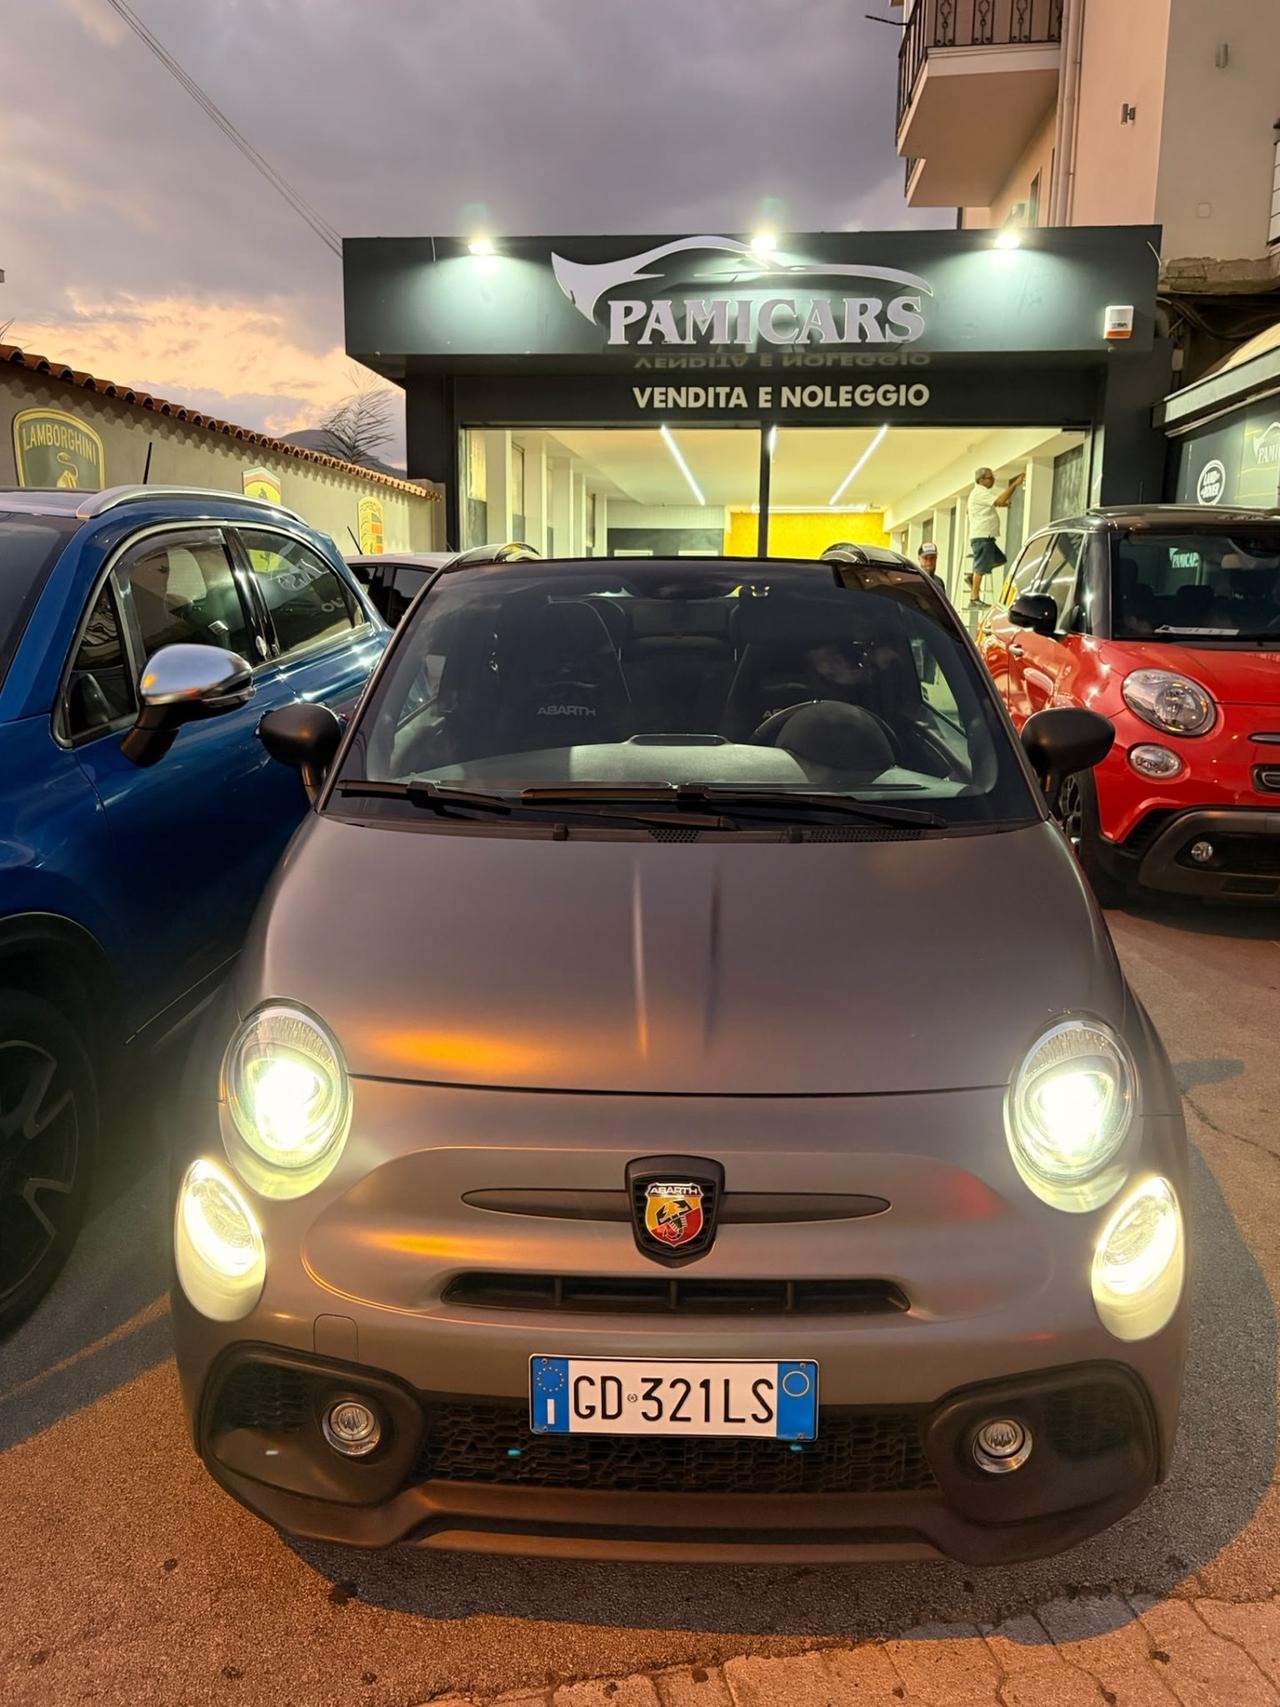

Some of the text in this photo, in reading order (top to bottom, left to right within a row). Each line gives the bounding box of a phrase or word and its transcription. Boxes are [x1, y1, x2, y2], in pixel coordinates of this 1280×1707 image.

[607, 296, 926, 345] PAMICARS
[632, 384, 930, 408] VENDITA E NOLEGGIO
[22, 423, 97, 466] LAMBORGHINI
[536, 704, 597, 717] ABARTH
[650, 1185, 698, 1195] ABARTH
[573, 1375, 623, 1420] GD
[640, 1377, 774, 1424] 321LS
